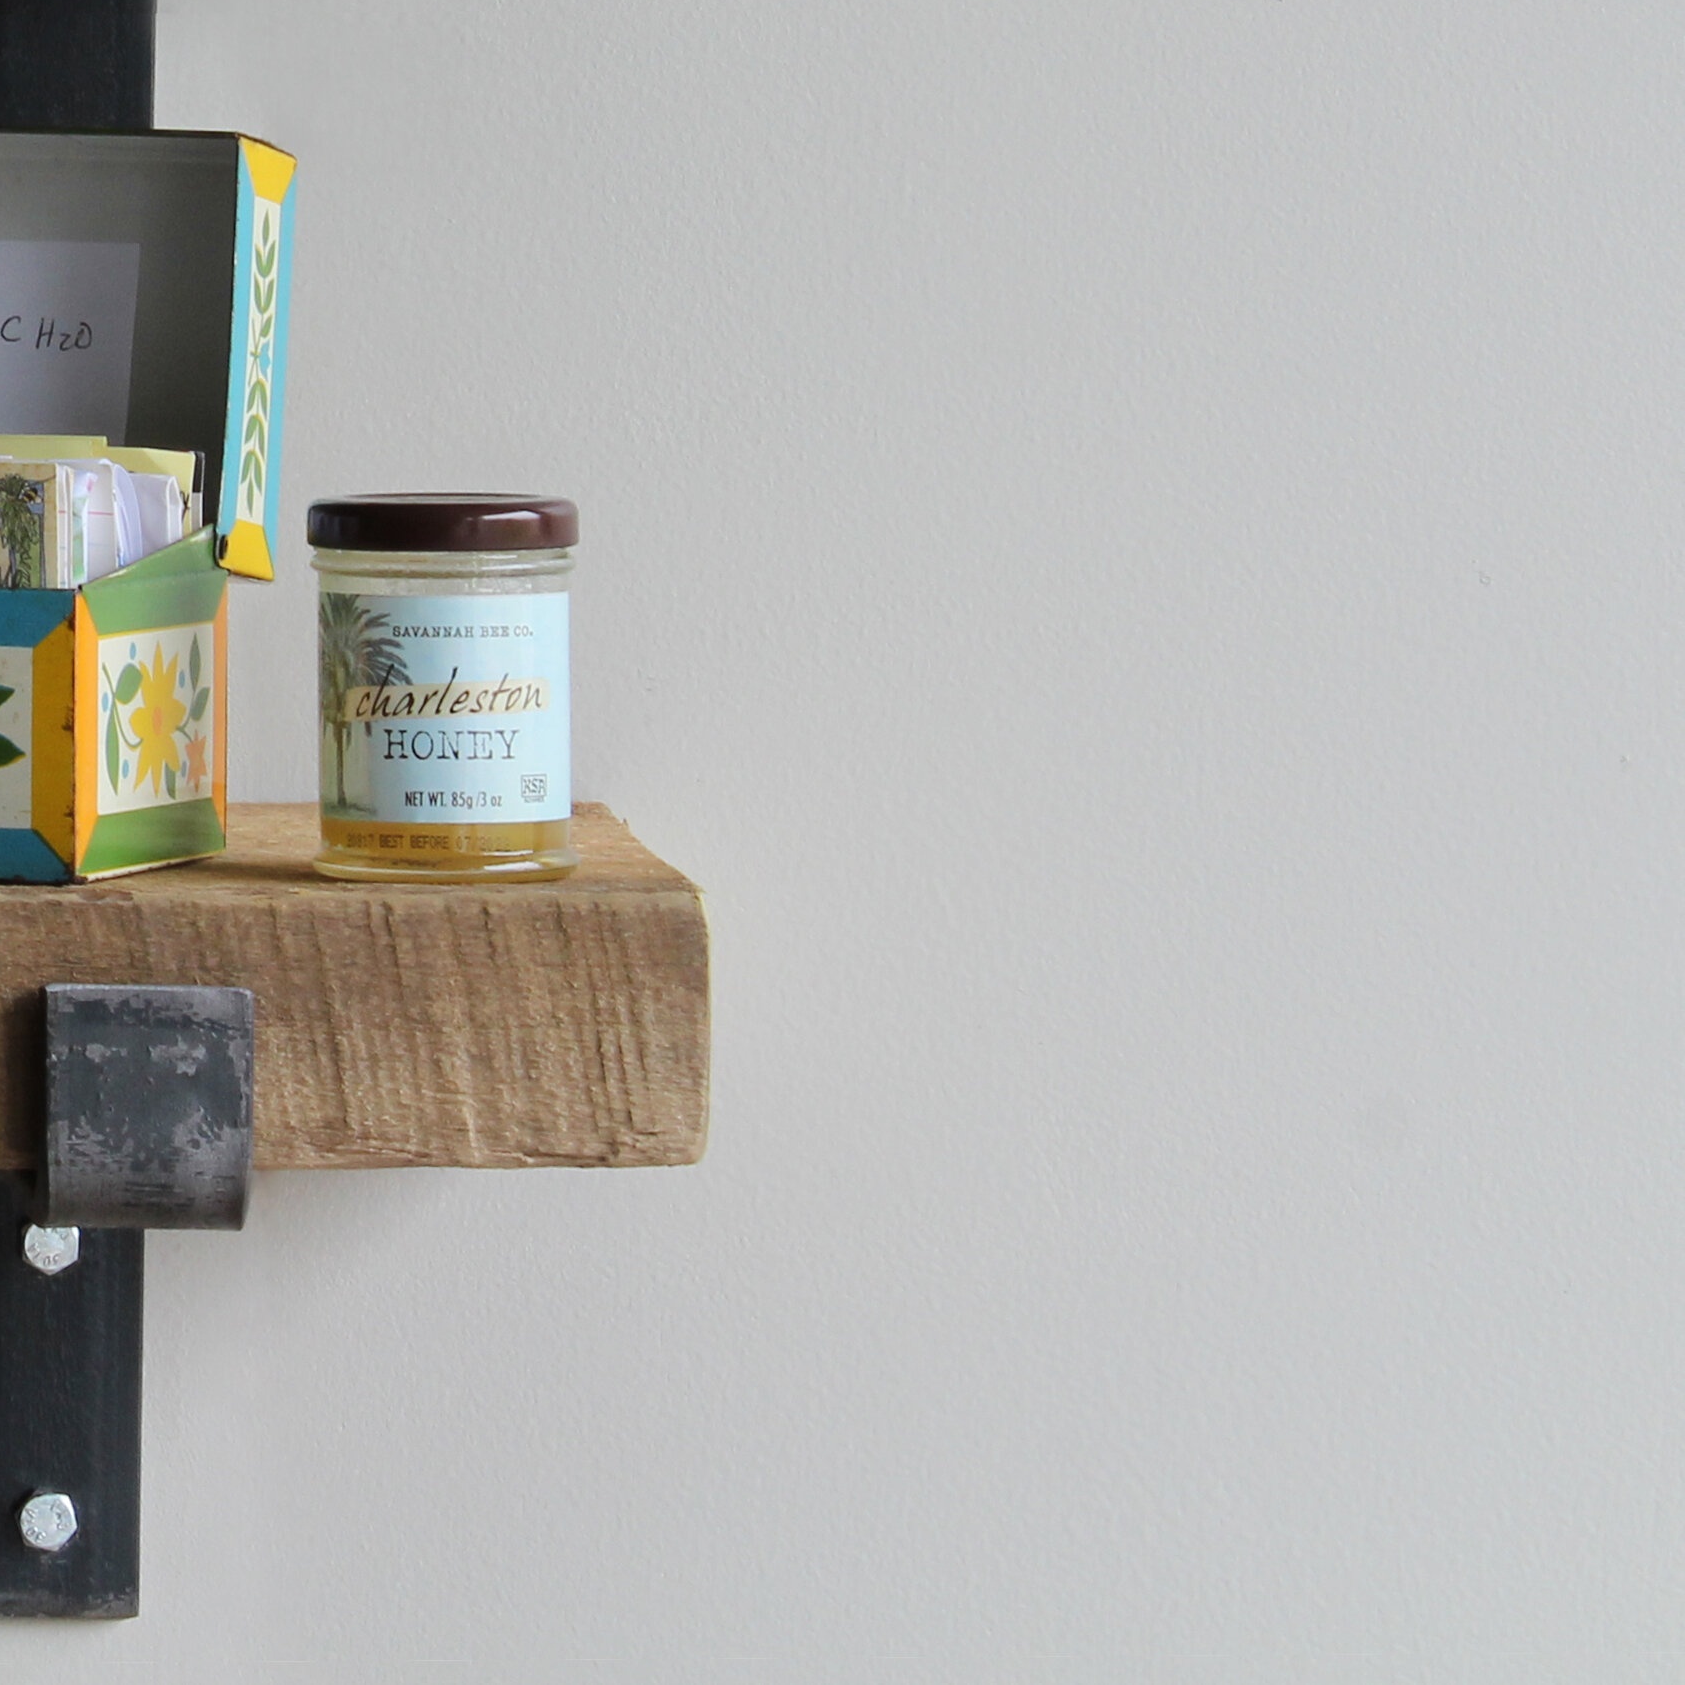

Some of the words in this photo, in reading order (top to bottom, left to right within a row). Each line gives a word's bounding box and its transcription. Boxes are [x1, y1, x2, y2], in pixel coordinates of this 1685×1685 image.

[392, 625, 474, 639] SAVANNAH
[480, 625, 509, 638] BEE
[355, 663, 543, 718] charleston
[383, 728, 521, 761] HONEY
[404, 790, 424, 808] NET
